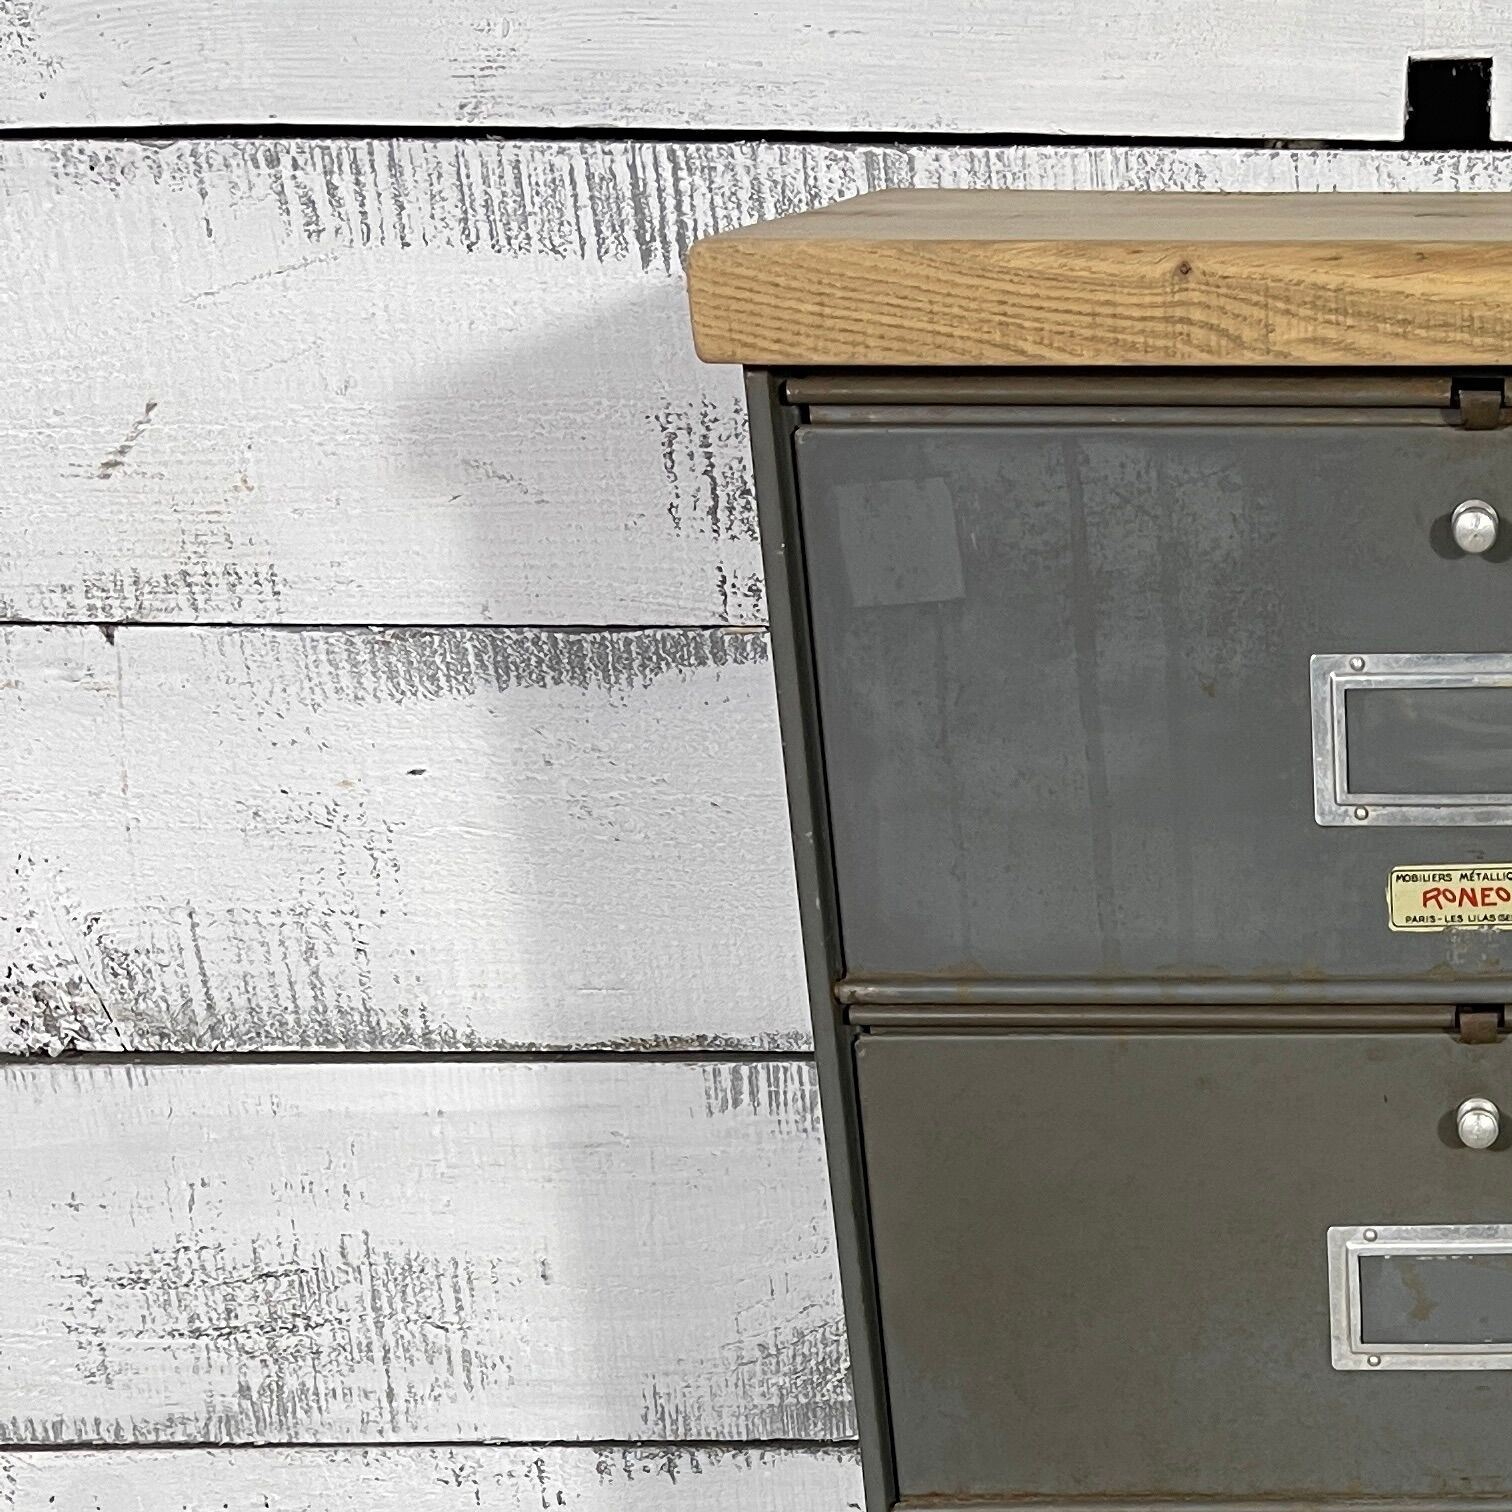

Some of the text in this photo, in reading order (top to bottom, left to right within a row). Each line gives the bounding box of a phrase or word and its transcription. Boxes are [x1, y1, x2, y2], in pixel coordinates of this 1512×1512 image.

[1396, 872, 1453, 883] MOBILIERS
[1422, 887, 1511, 910] RONEO
[1468, 914, 1496, 922] LILAS
